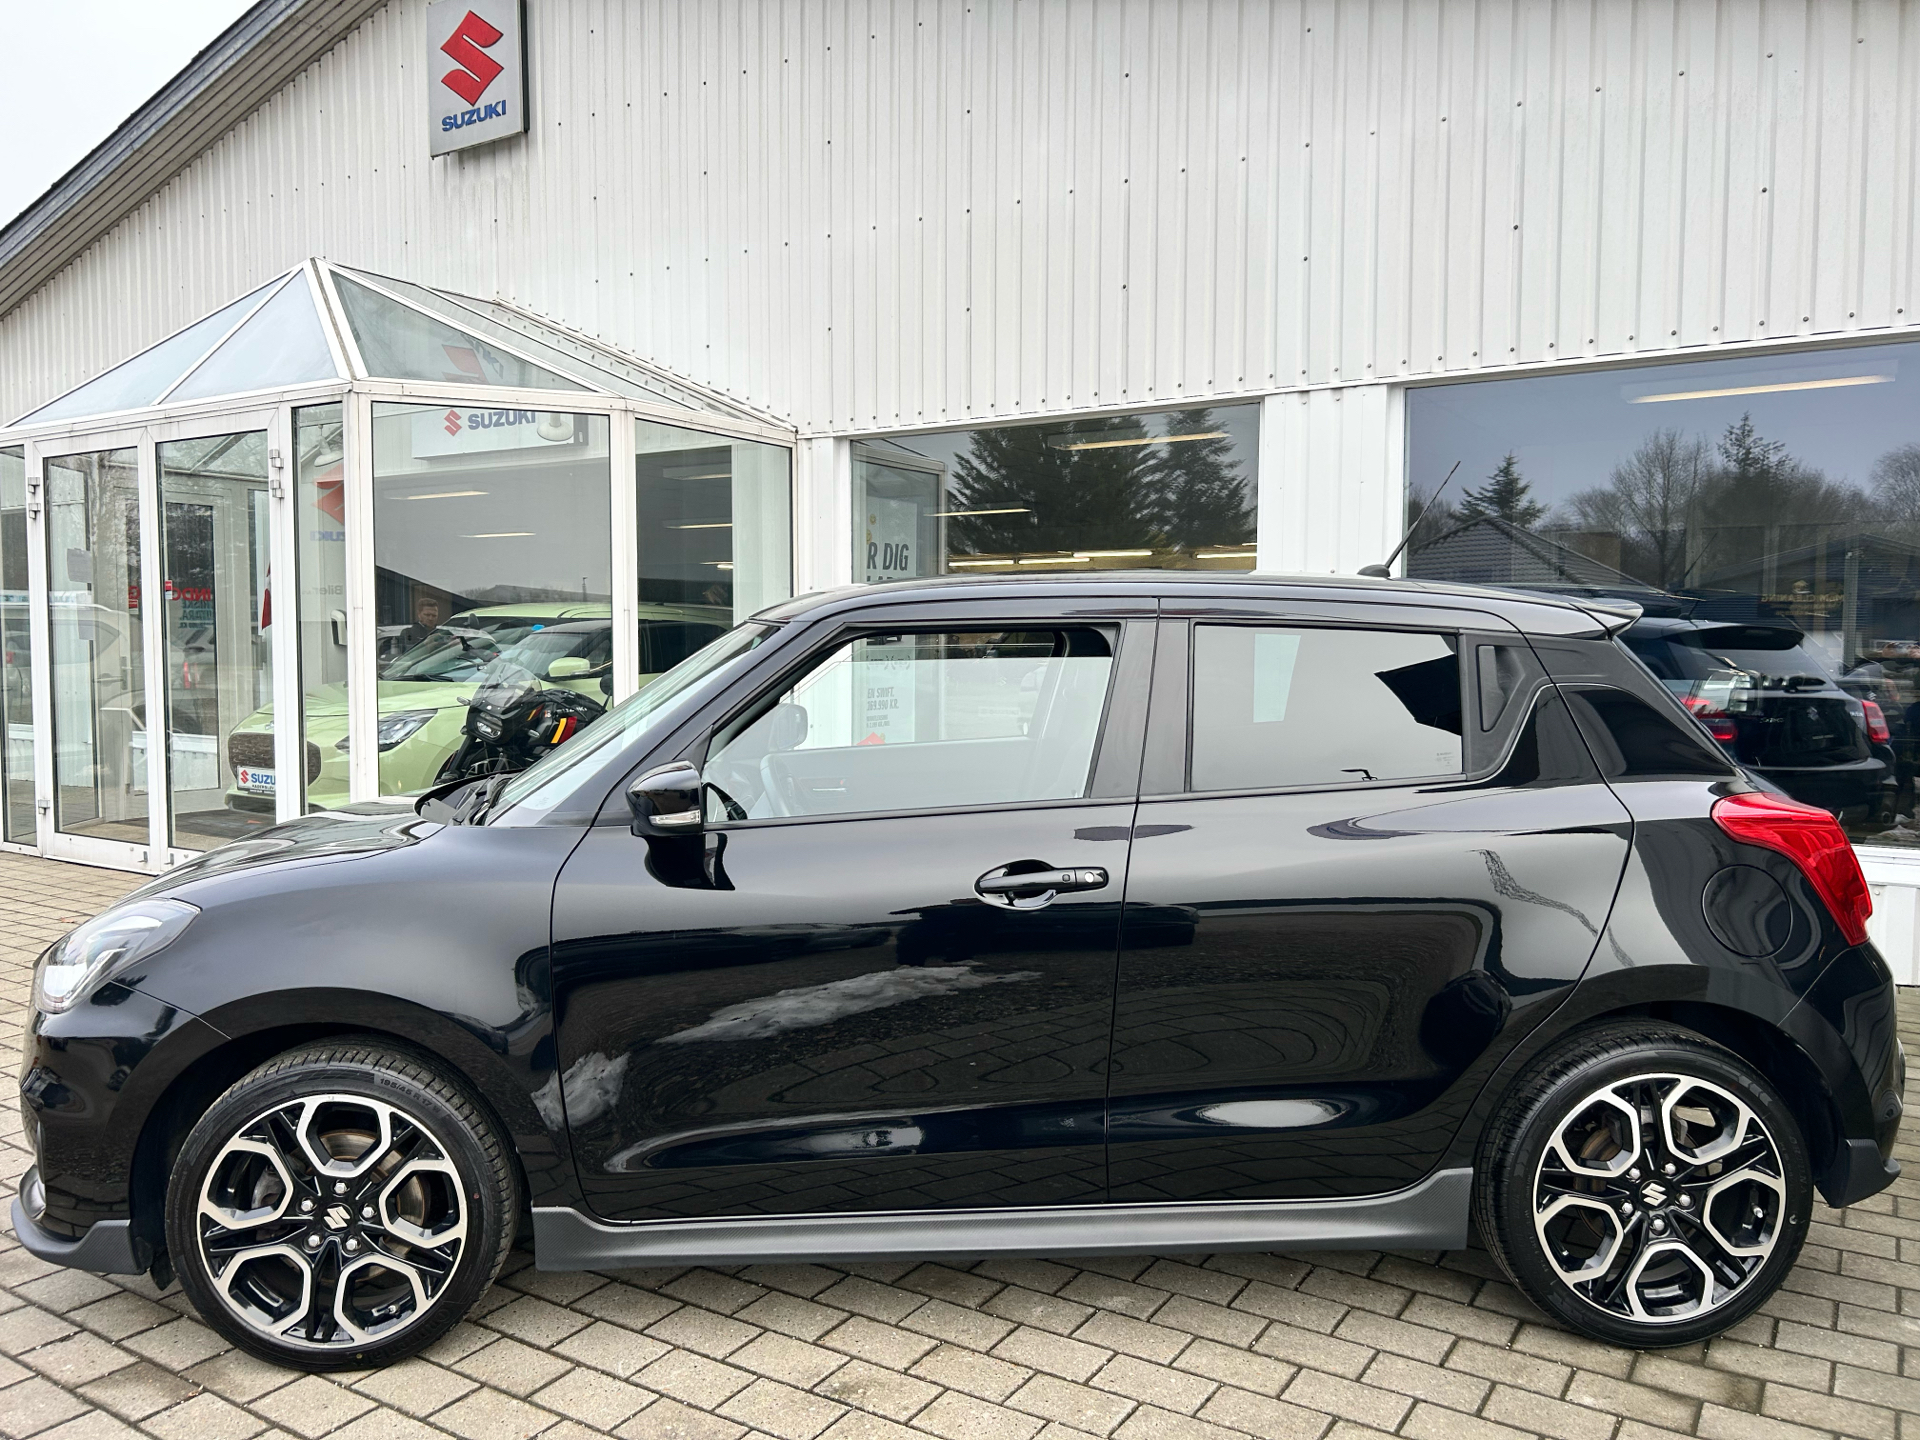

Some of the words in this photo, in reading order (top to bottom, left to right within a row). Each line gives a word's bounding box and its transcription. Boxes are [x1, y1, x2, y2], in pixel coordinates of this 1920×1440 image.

[441, 99, 507, 132] SUZUKI
[467, 410, 536, 431] SUZUKI
[882, 542, 909, 571] DIG
[380, 1078, 413, 1096] 195/45
